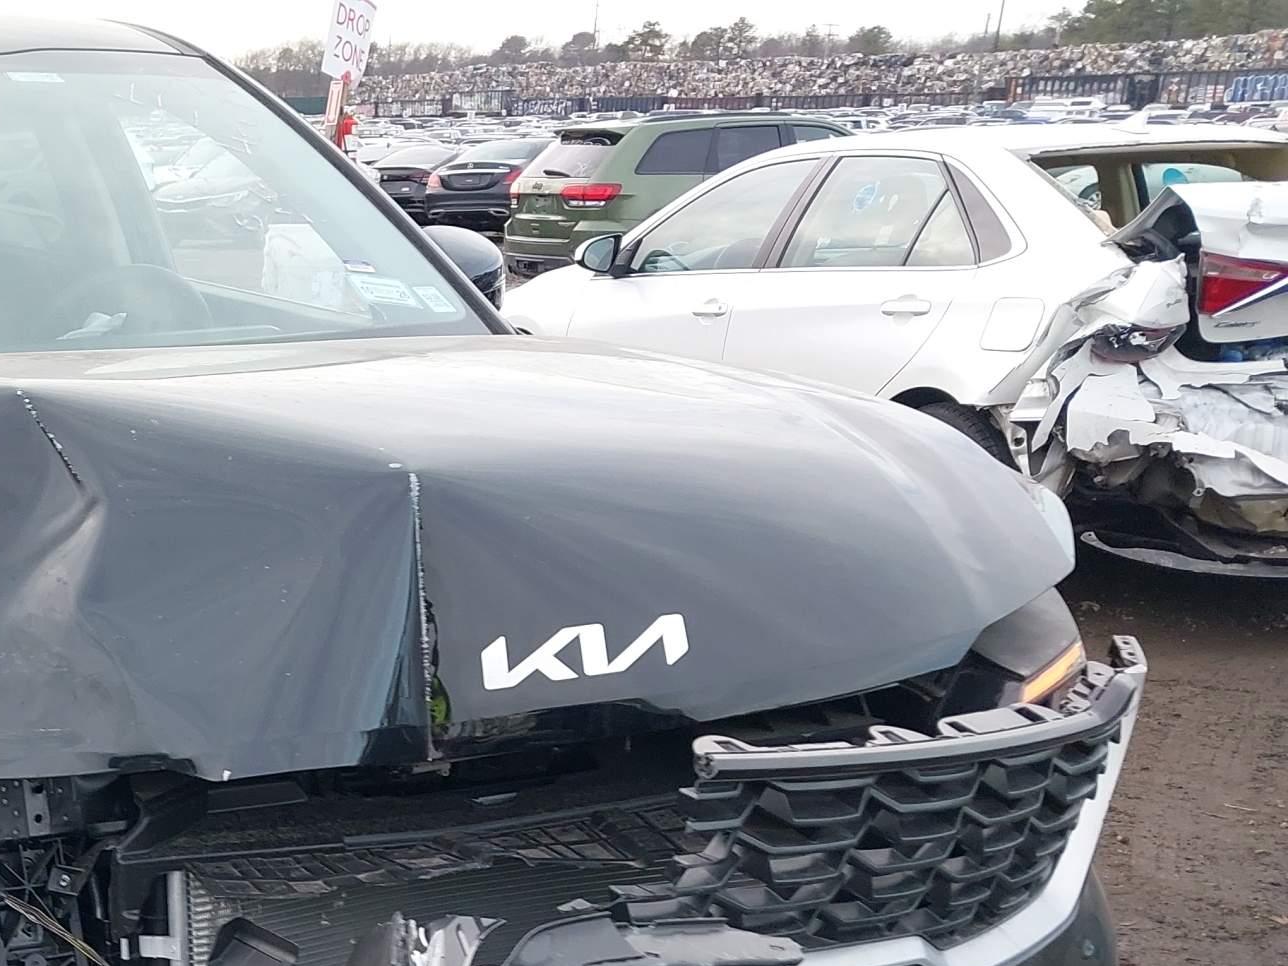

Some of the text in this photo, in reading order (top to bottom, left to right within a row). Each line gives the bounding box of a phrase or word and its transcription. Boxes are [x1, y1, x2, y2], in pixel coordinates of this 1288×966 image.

[336, 2, 371, 39] DROP
[333, 34, 366, 73] ZONE
[480, 613, 690, 691] KIA
